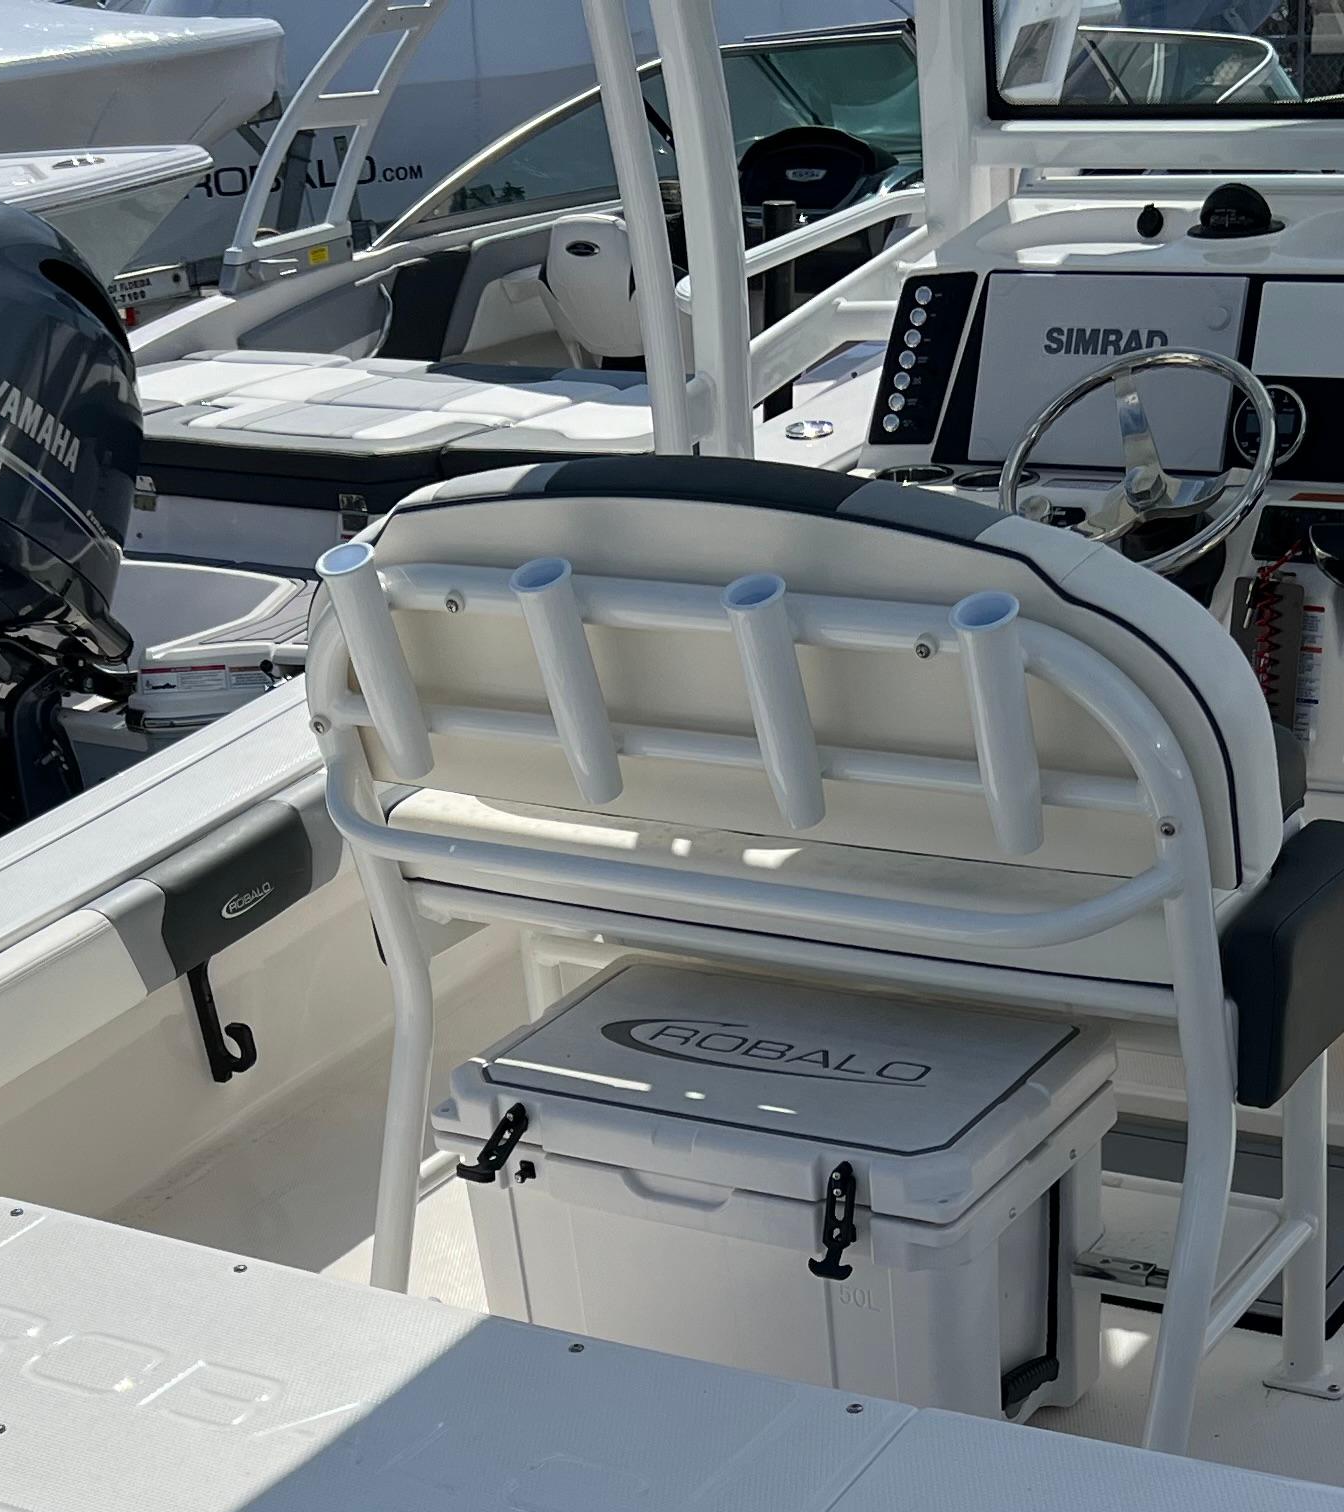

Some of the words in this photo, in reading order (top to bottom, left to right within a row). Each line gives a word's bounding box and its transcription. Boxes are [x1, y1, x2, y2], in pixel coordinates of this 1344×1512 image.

[1044, 327, 1168, 355] SIMRAD
[229, 881, 271, 912] ROBALO
[648, 1025, 932, 1082] ROBALO
[839, 1284, 881, 1313] 50L
